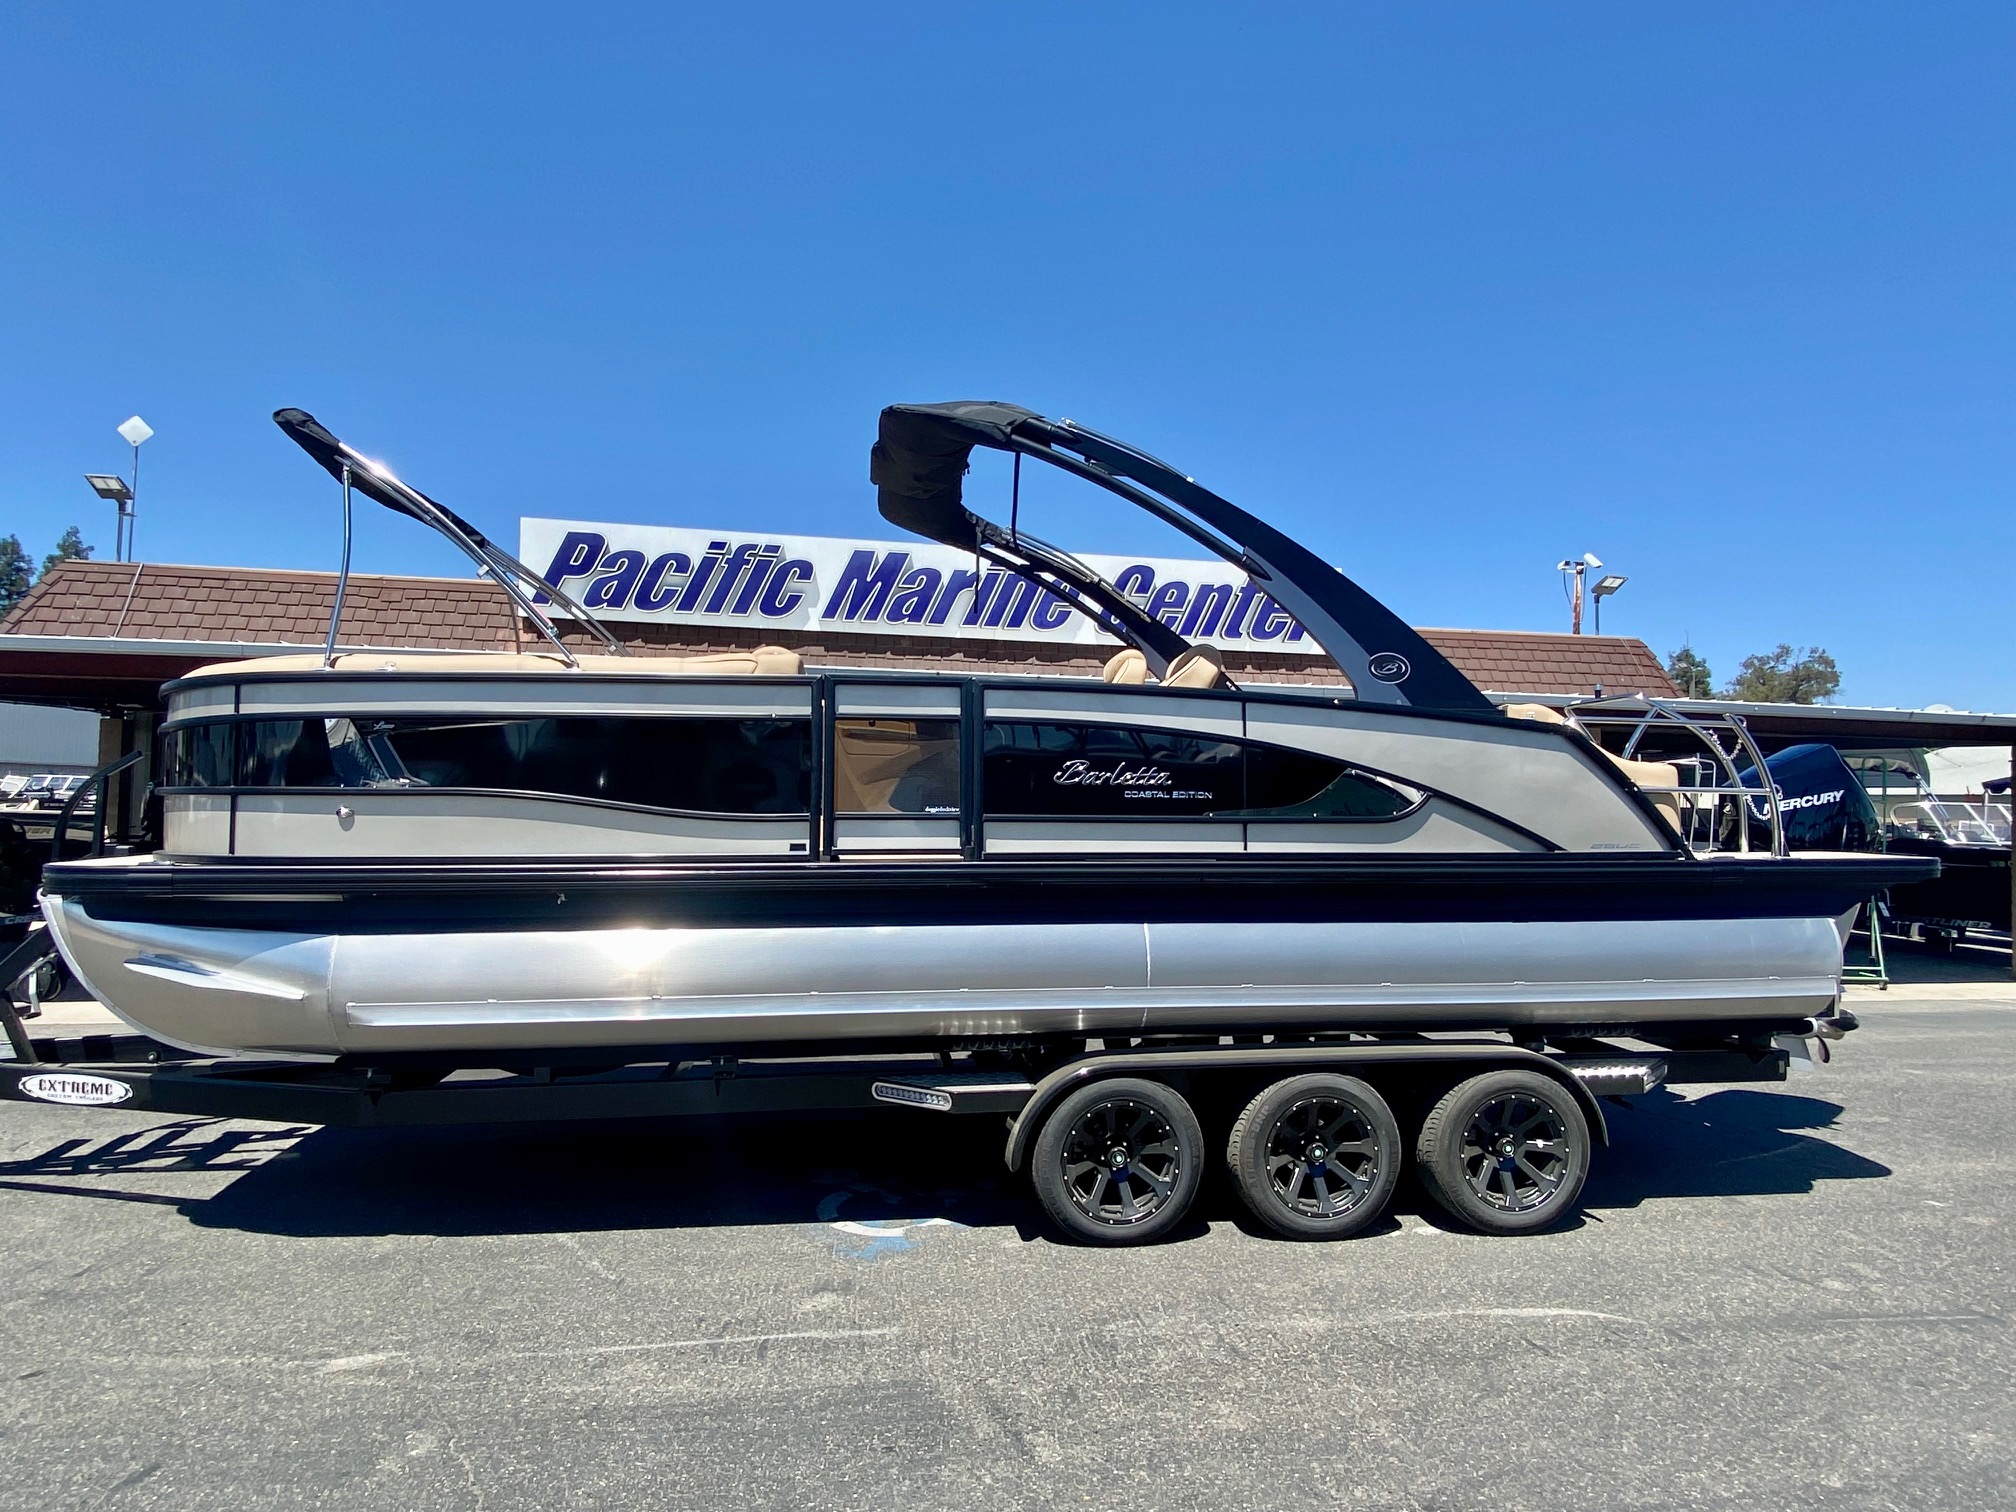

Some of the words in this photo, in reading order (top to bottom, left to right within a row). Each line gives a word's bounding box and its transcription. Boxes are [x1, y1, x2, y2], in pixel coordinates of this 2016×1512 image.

[531, 530, 814, 620] Pacific
[820, 548, 1081, 631] Marine
[1095, 564, 1305, 642] Cente
[1053, 759, 1173, 786] Barletta
[1124, 790, 1170, 799] COASTAL
[1172, 790, 1213, 799] EDITION
[38, 1079, 113, 1096] EXTREME
